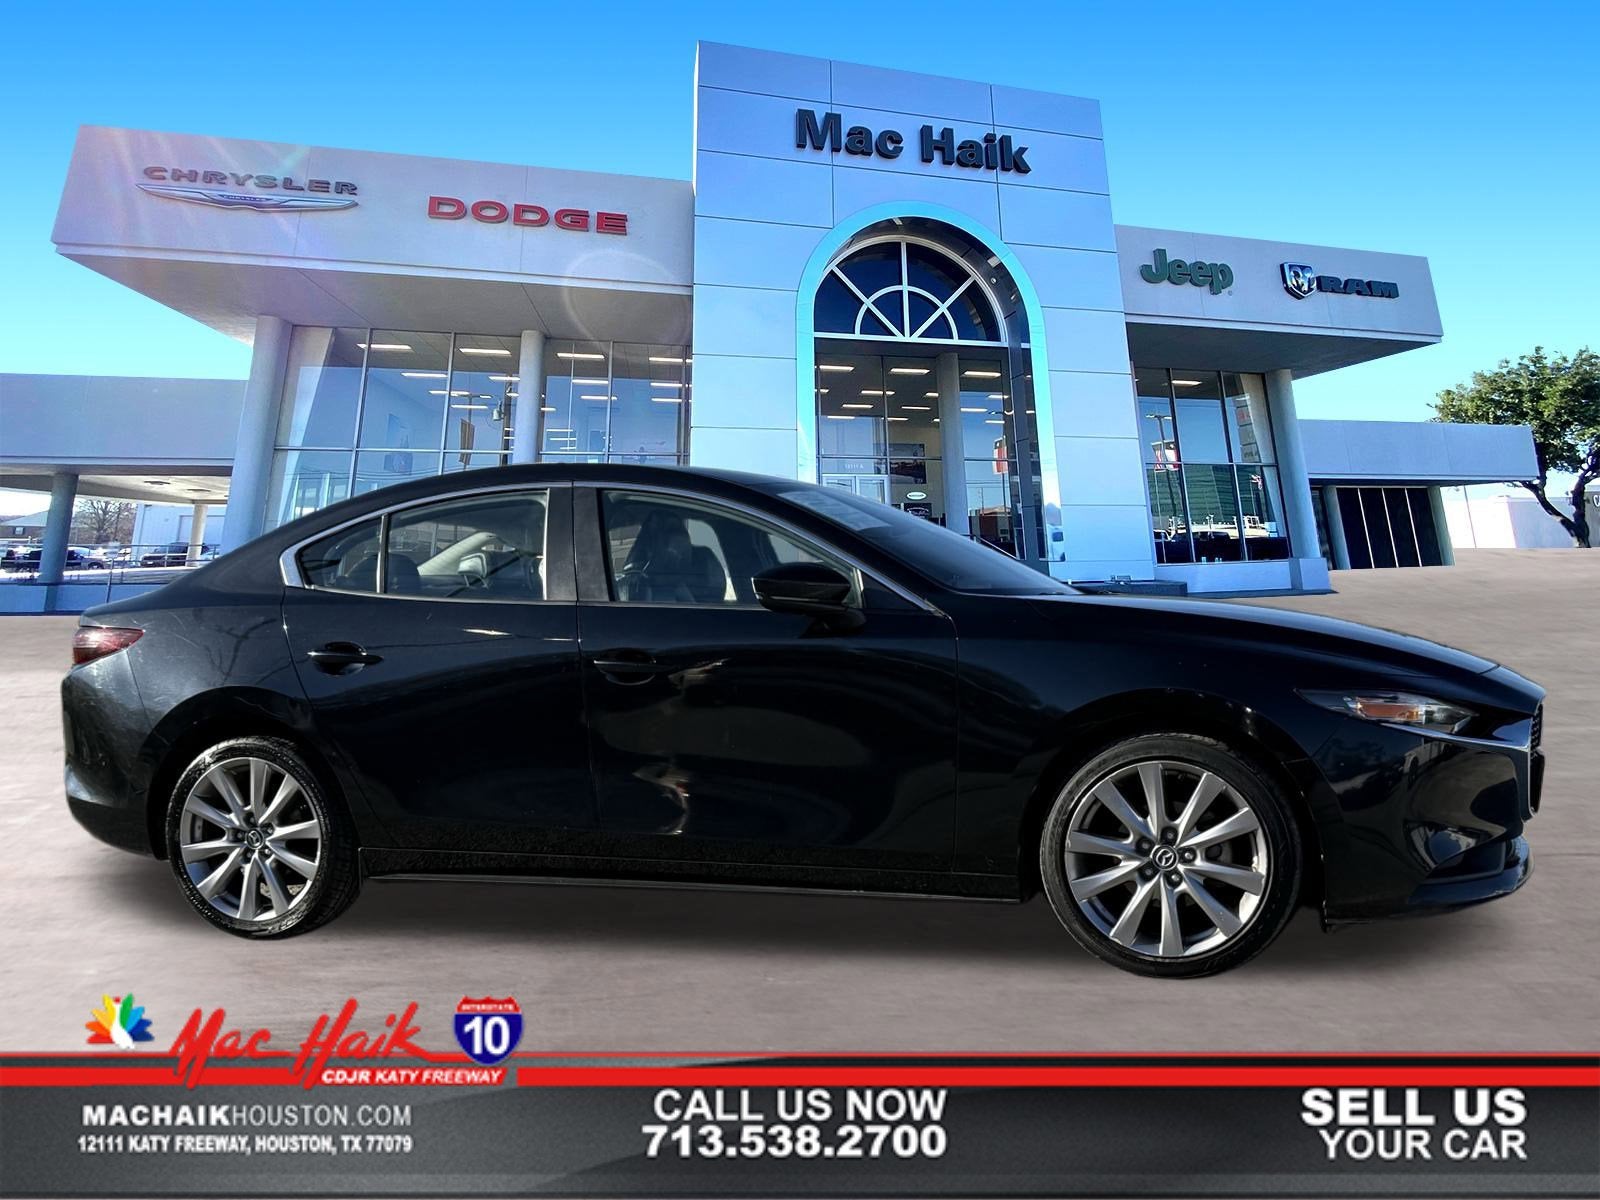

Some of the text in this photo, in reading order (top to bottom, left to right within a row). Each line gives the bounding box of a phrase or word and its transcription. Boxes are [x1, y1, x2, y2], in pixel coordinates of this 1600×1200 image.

[796, 108, 1032, 174] Mac Haik
[143, 166, 358, 196] CHRYSLER
[428, 195, 628, 236] DODGE
[1140, 248, 1234, 295] Jeep
[1316, 275, 1400, 299] RAM
